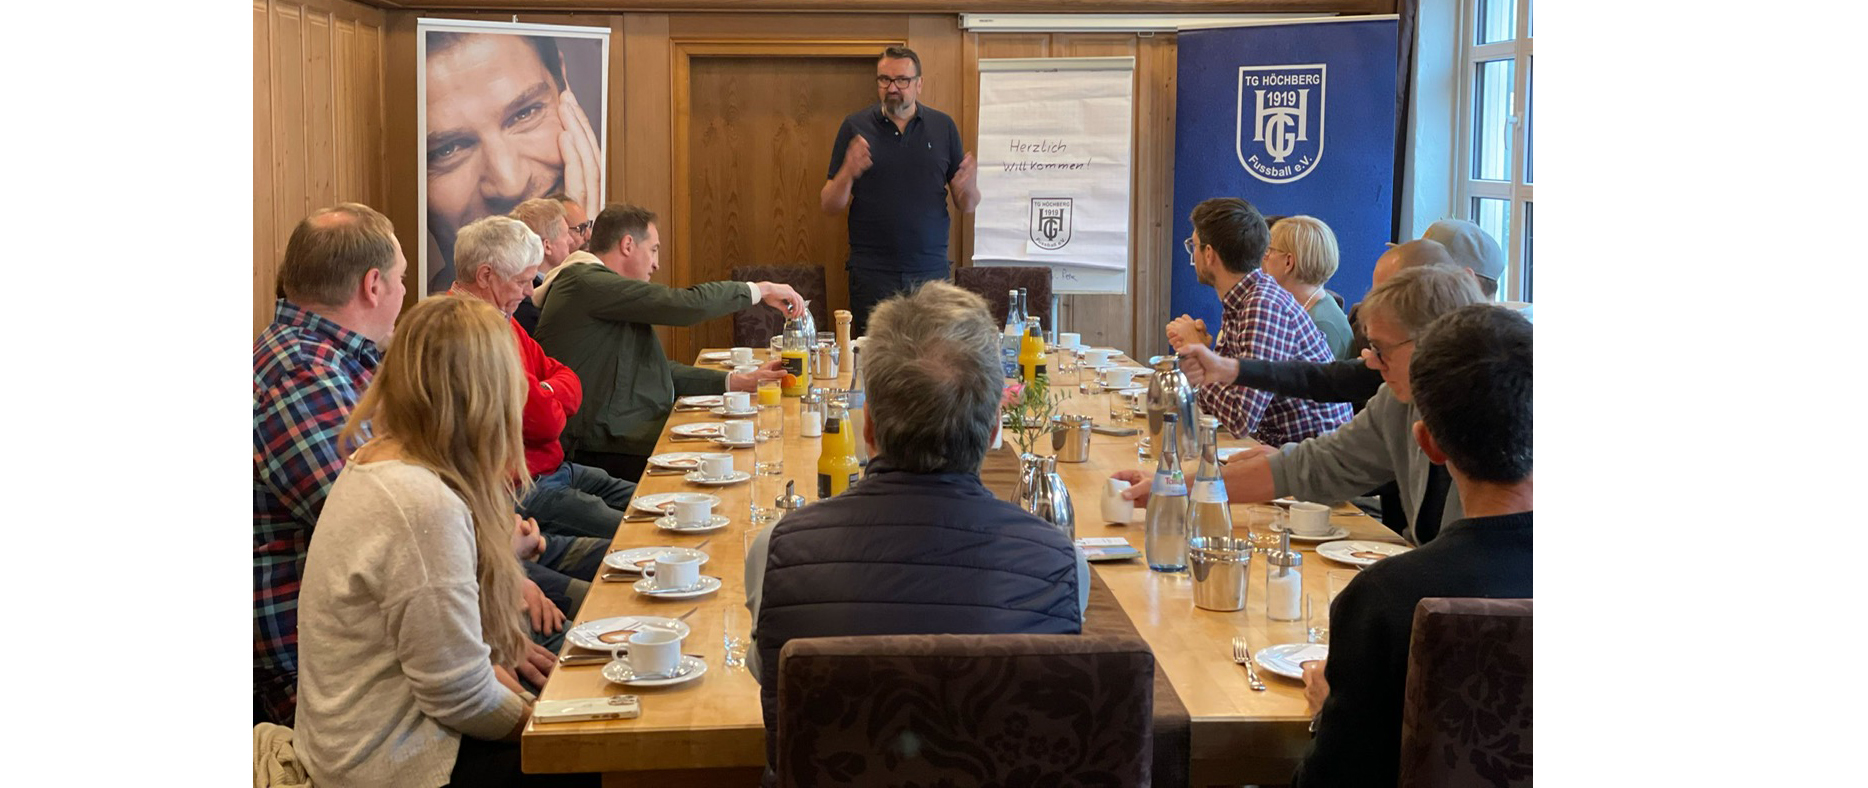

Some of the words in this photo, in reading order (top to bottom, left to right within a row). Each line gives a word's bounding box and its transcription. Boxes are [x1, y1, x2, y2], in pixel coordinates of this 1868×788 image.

[1245, 76, 1259, 86] TG
[1262, 73, 1320, 86] HÖCHBERG
[1267, 91, 1297, 106] 1919
[1009, 139, 1067, 153] Herzlich
[1248, 154, 1292, 177] Fussball
[1294, 155, 1313, 173] e.V.
